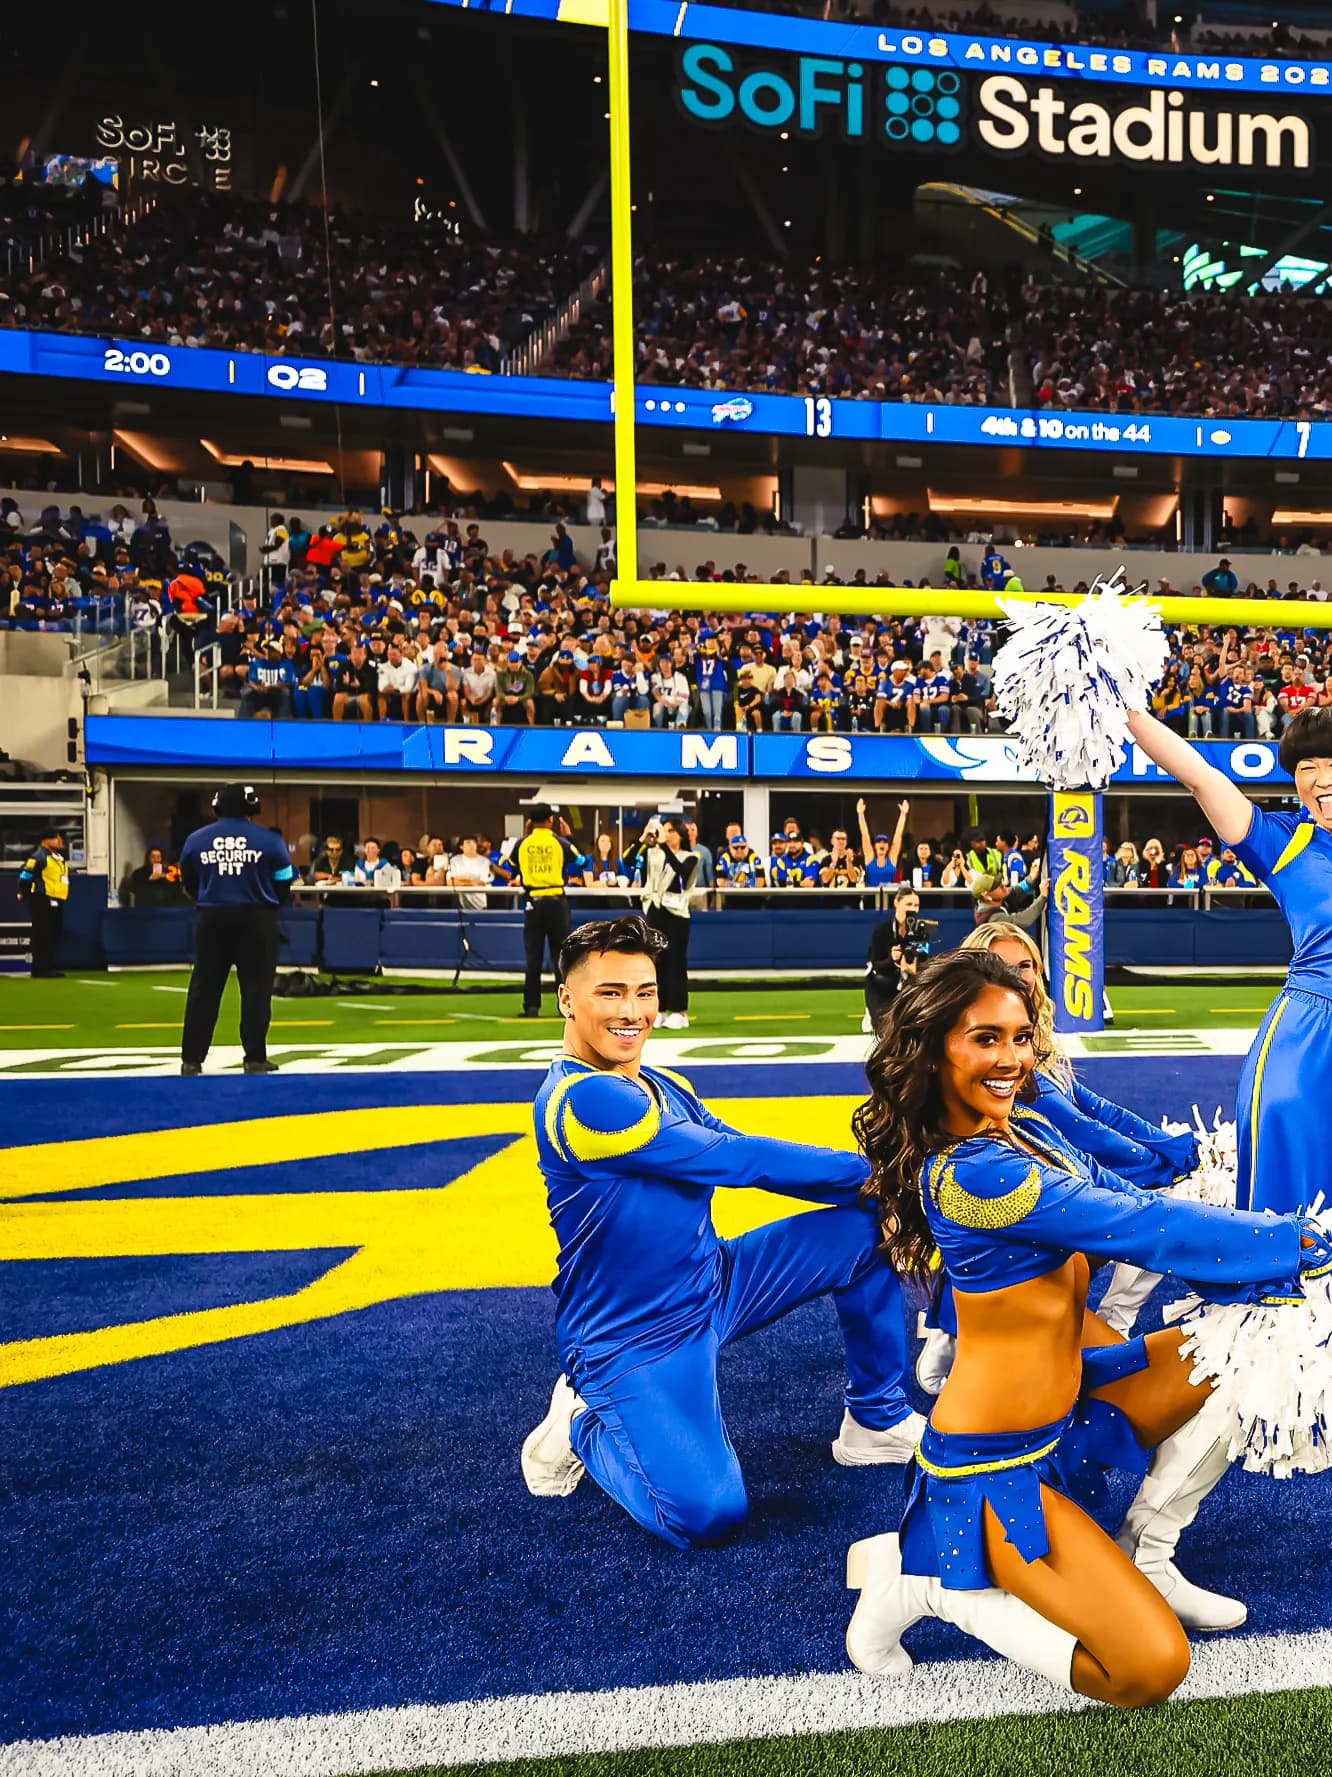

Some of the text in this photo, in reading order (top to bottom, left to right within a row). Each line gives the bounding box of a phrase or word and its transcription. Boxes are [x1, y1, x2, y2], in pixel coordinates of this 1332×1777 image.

[878, 34, 949, 57] LOS
[965, 43, 1132, 74] ANGELES
[1148, 59, 1244, 81] RAMS
[681, 44, 1310, 168] SoFi Stadium
[104, 349, 171, 376] 2:00
[804, 398, 831, 437] 13
[980, 416, 1151, 443] 4th & 10 on the 44
[1297, 422, 1311, 458] 7
[701, 659, 715, 676] 17
[200, 849, 262, 864] SECURITY
[213, 836, 247, 850] CSC
[527, 845, 553, 855] CSC
[218, 862, 244, 876] FIT
[527, 864, 553, 874] STAFF
[1054, 848, 1094, 1021] RAMS
